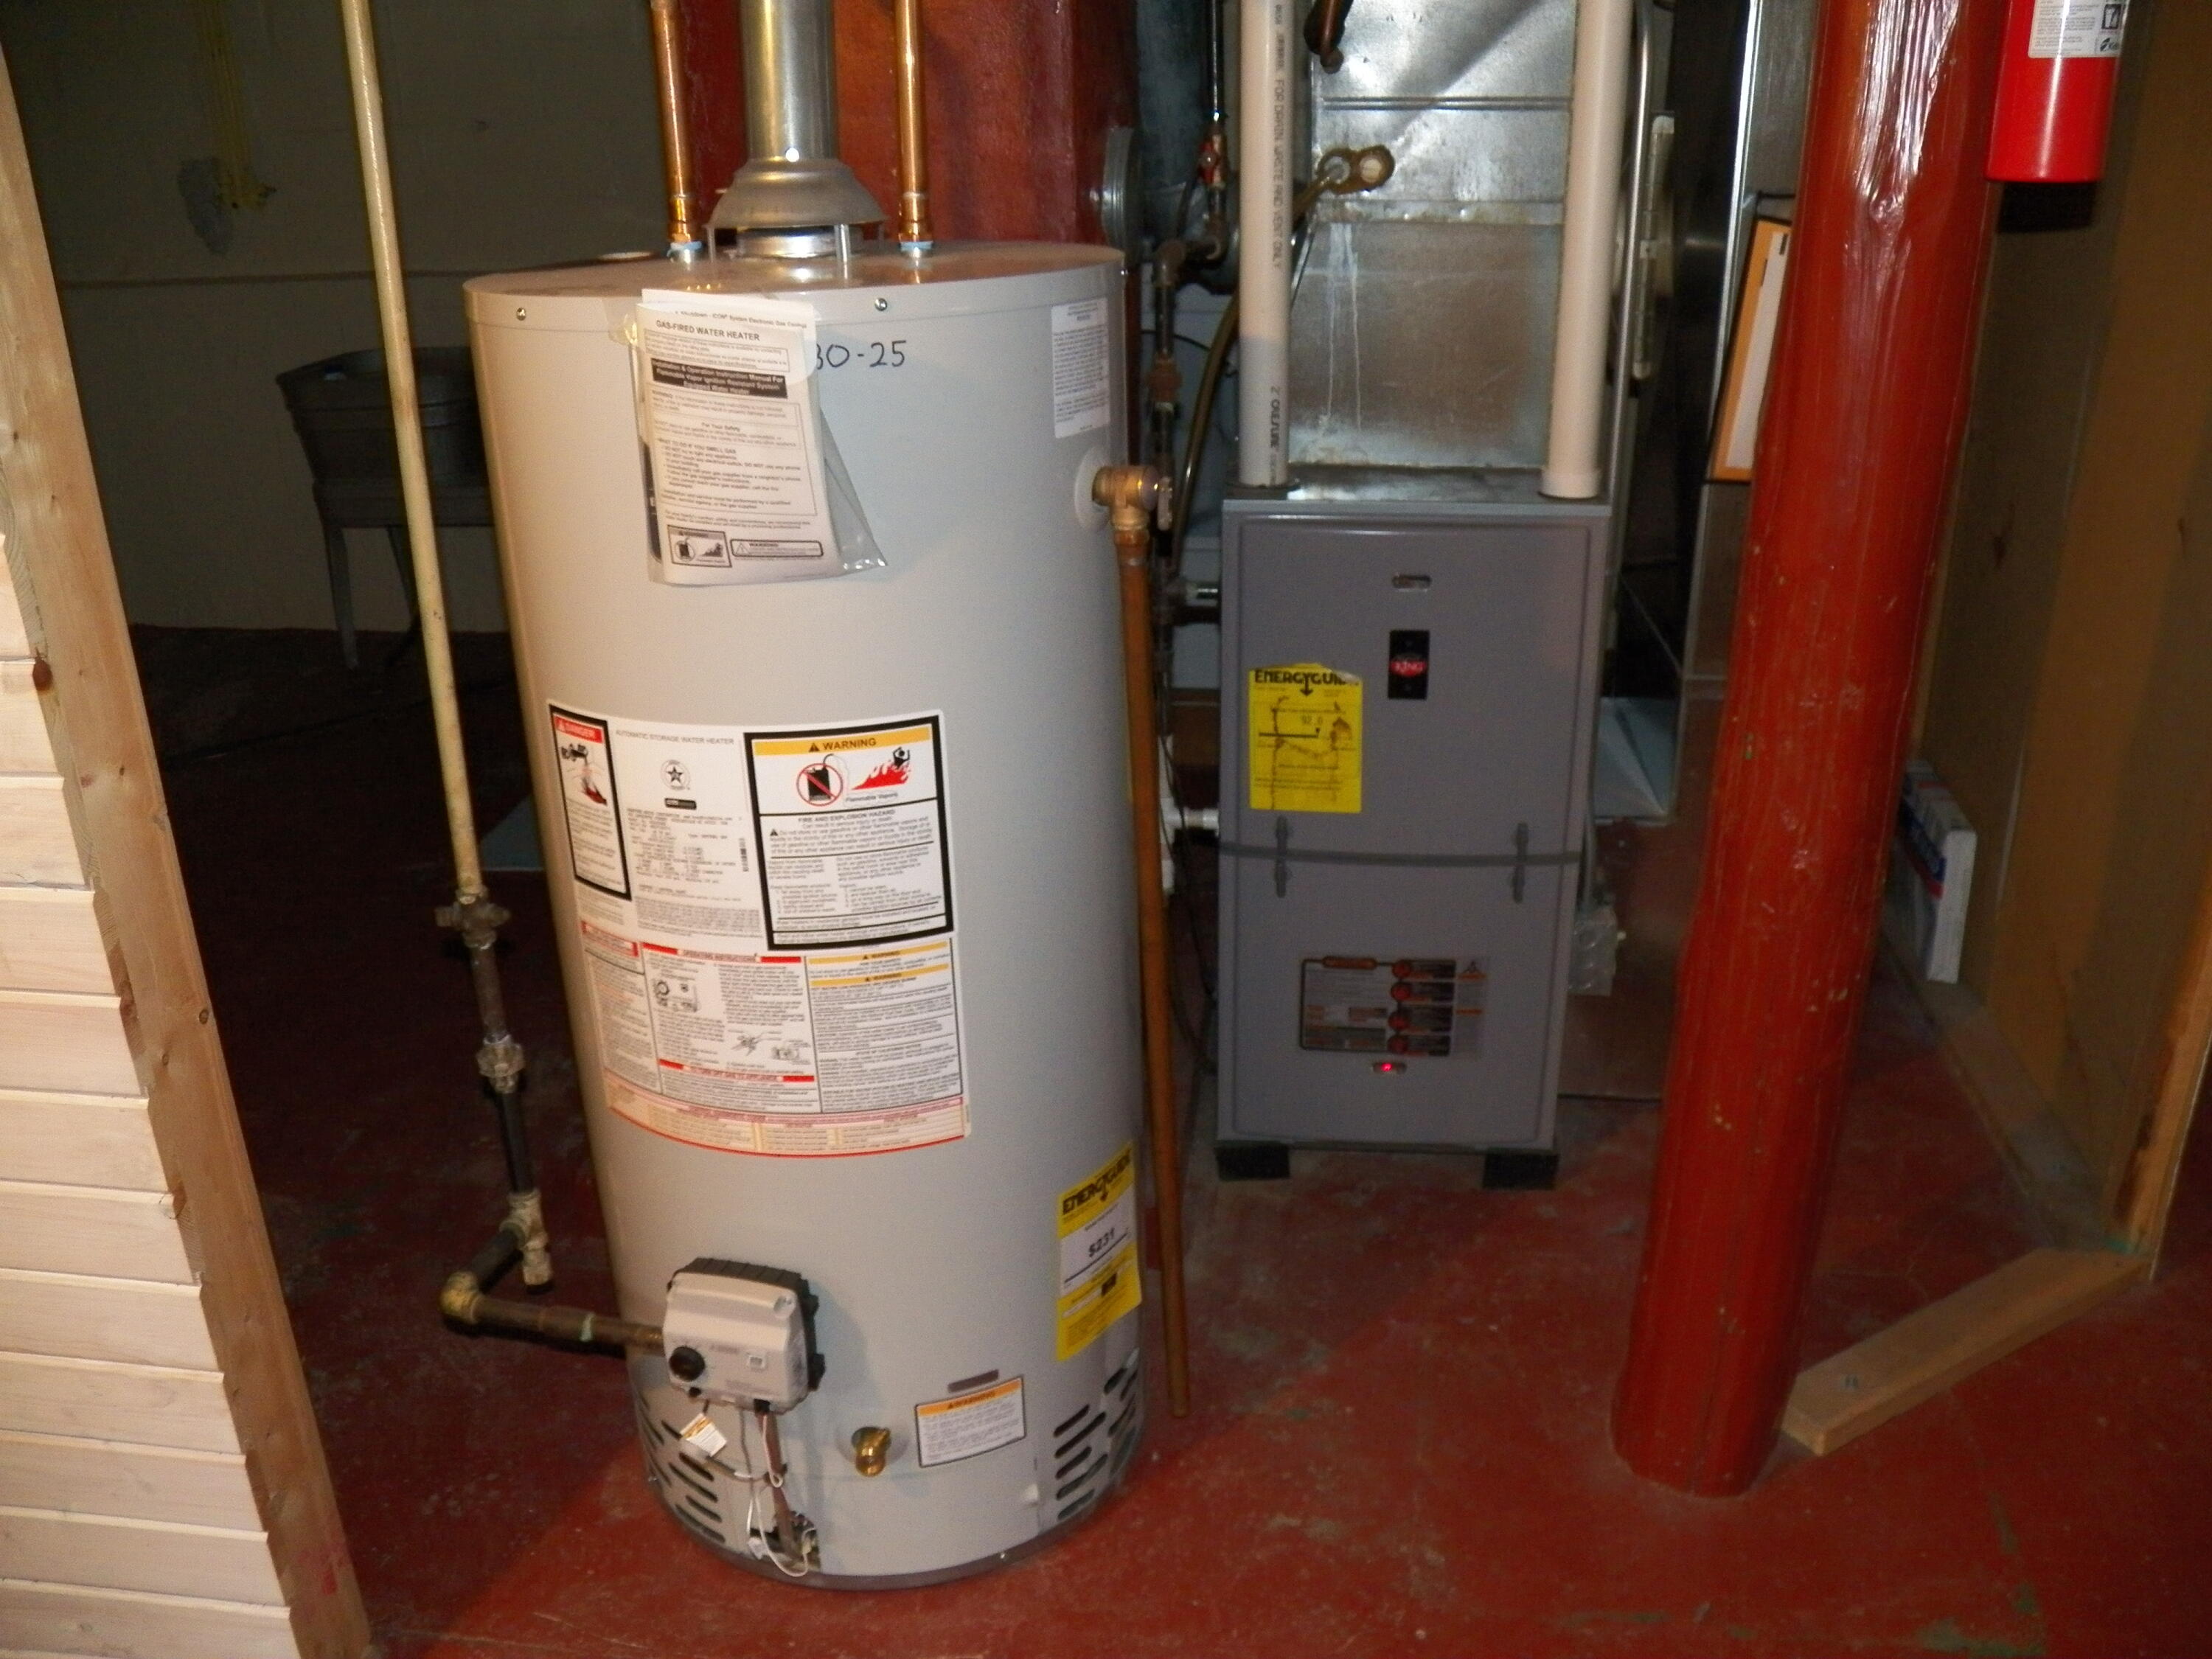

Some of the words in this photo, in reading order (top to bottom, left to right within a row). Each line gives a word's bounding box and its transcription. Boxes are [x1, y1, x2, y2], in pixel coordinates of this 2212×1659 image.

[655, 319, 695, 333] GAS-FIRED
[696, 326, 725, 337] WATER
[726, 330, 760, 341] HEATER
[823, 737, 877, 751] WARNING
